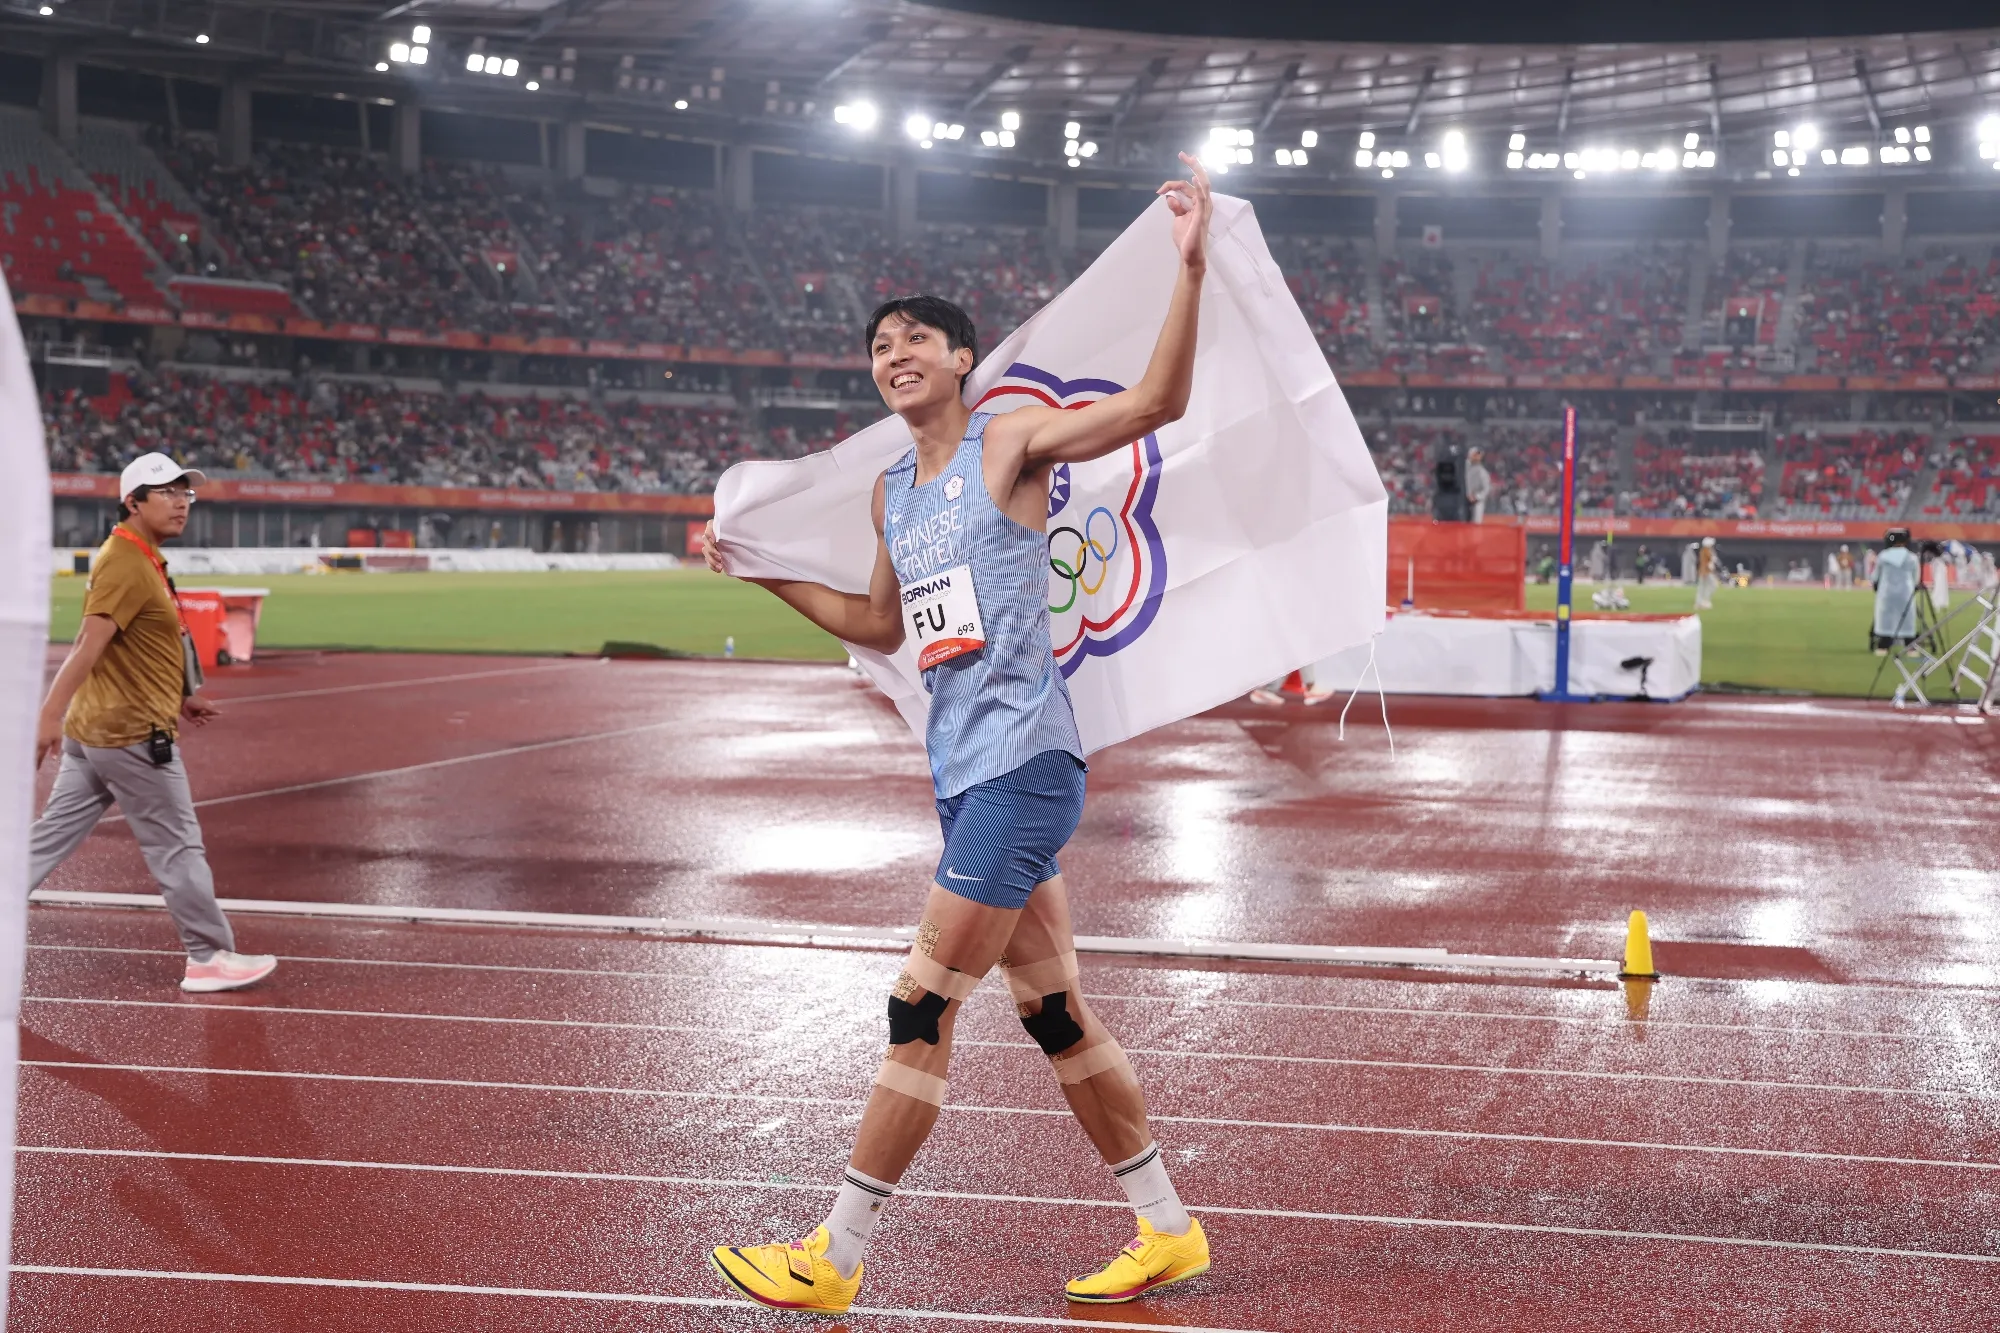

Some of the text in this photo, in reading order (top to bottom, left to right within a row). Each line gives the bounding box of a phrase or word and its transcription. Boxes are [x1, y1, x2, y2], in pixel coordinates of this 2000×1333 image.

[892, 505, 963, 560] CHINESE
[901, 576, 951, 606] BORNAN
[912, 603, 946, 639] FU
[957, 622, 975, 636] 693
